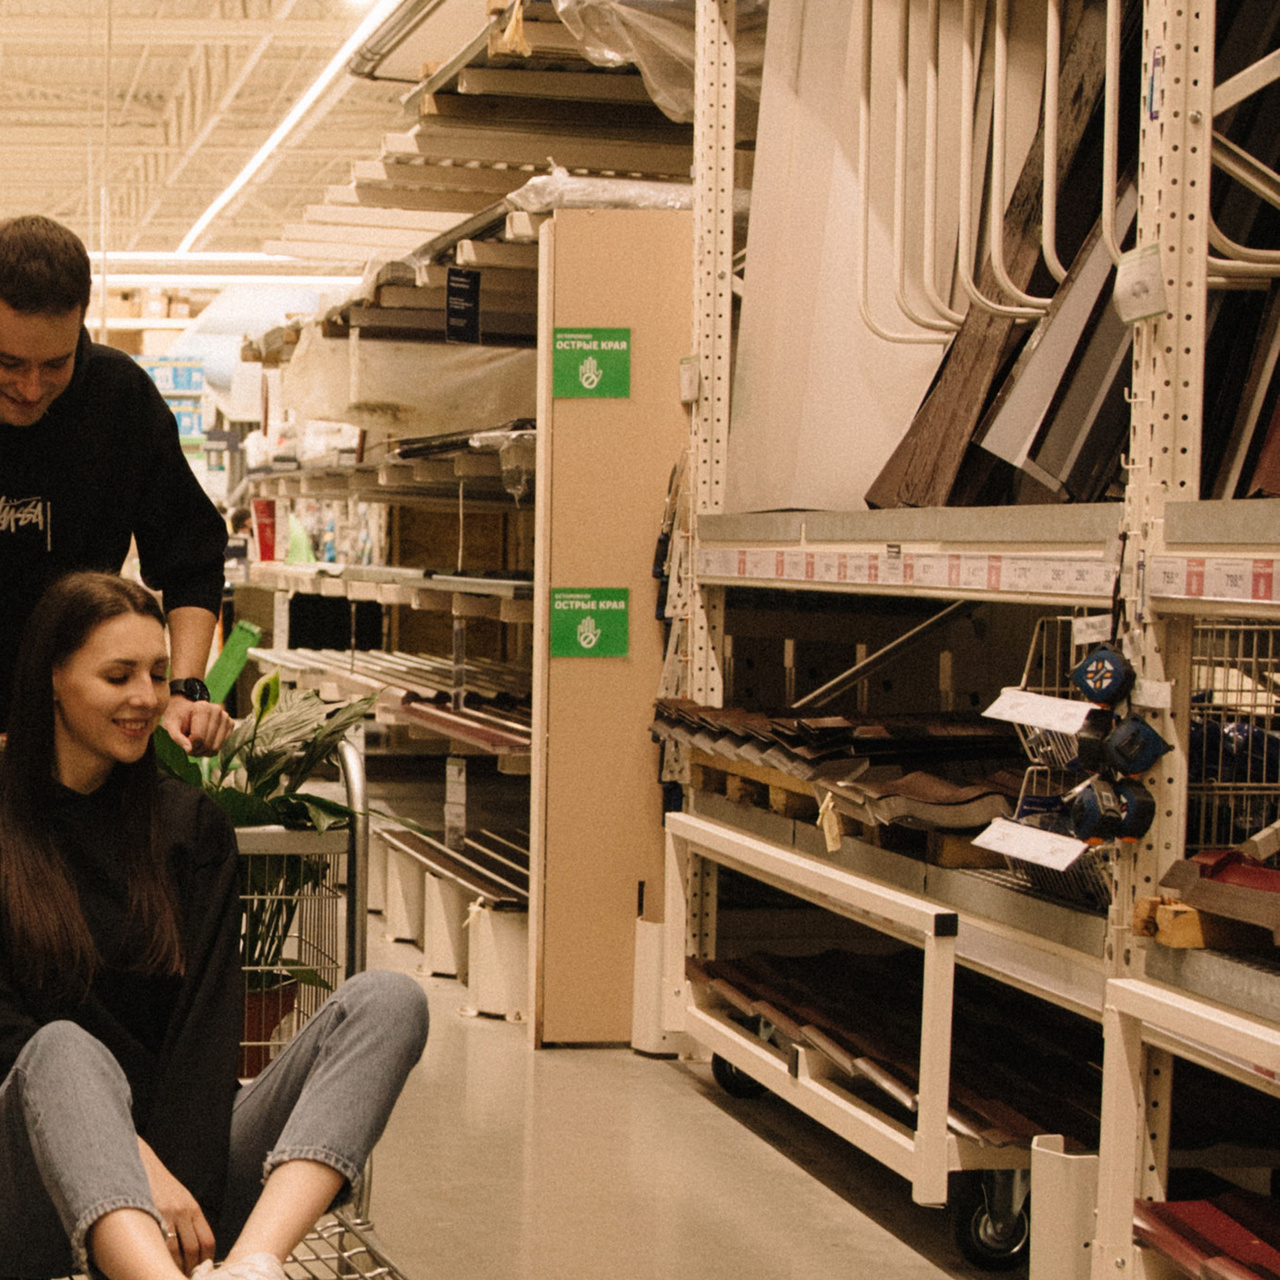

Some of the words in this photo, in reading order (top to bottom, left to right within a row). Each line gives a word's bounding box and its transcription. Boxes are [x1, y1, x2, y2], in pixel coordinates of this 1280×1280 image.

[556, 340, 599, 350] ОСТРЫЕ
[600, 340, 627, 350] КРАЯ
[554, 600, 597, 610] ОСТРЫЕ
[598, 600, 625, 610] КРАЯ
